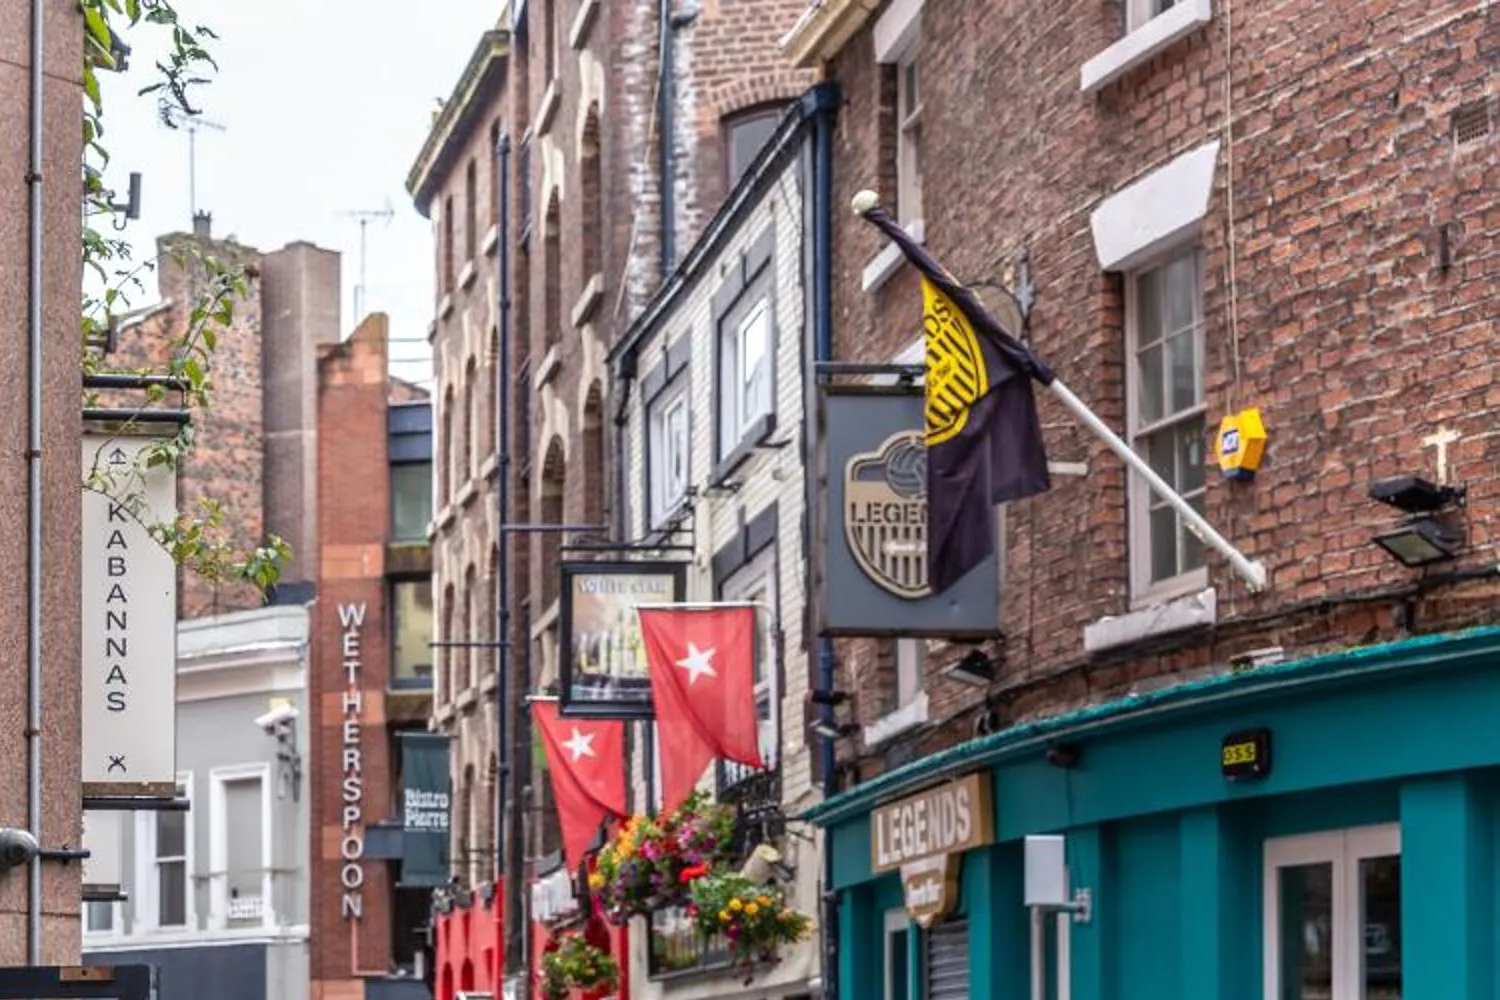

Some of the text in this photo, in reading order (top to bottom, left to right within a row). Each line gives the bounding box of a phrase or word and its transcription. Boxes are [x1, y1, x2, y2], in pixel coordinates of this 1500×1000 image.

[851, 502, 927, 524] LEGE
[106, 503, 127, 711] KABANNAS
[338, 603, 366, 918] WETHERSPOON
[877, 786, 971, 865] LEGENDS
